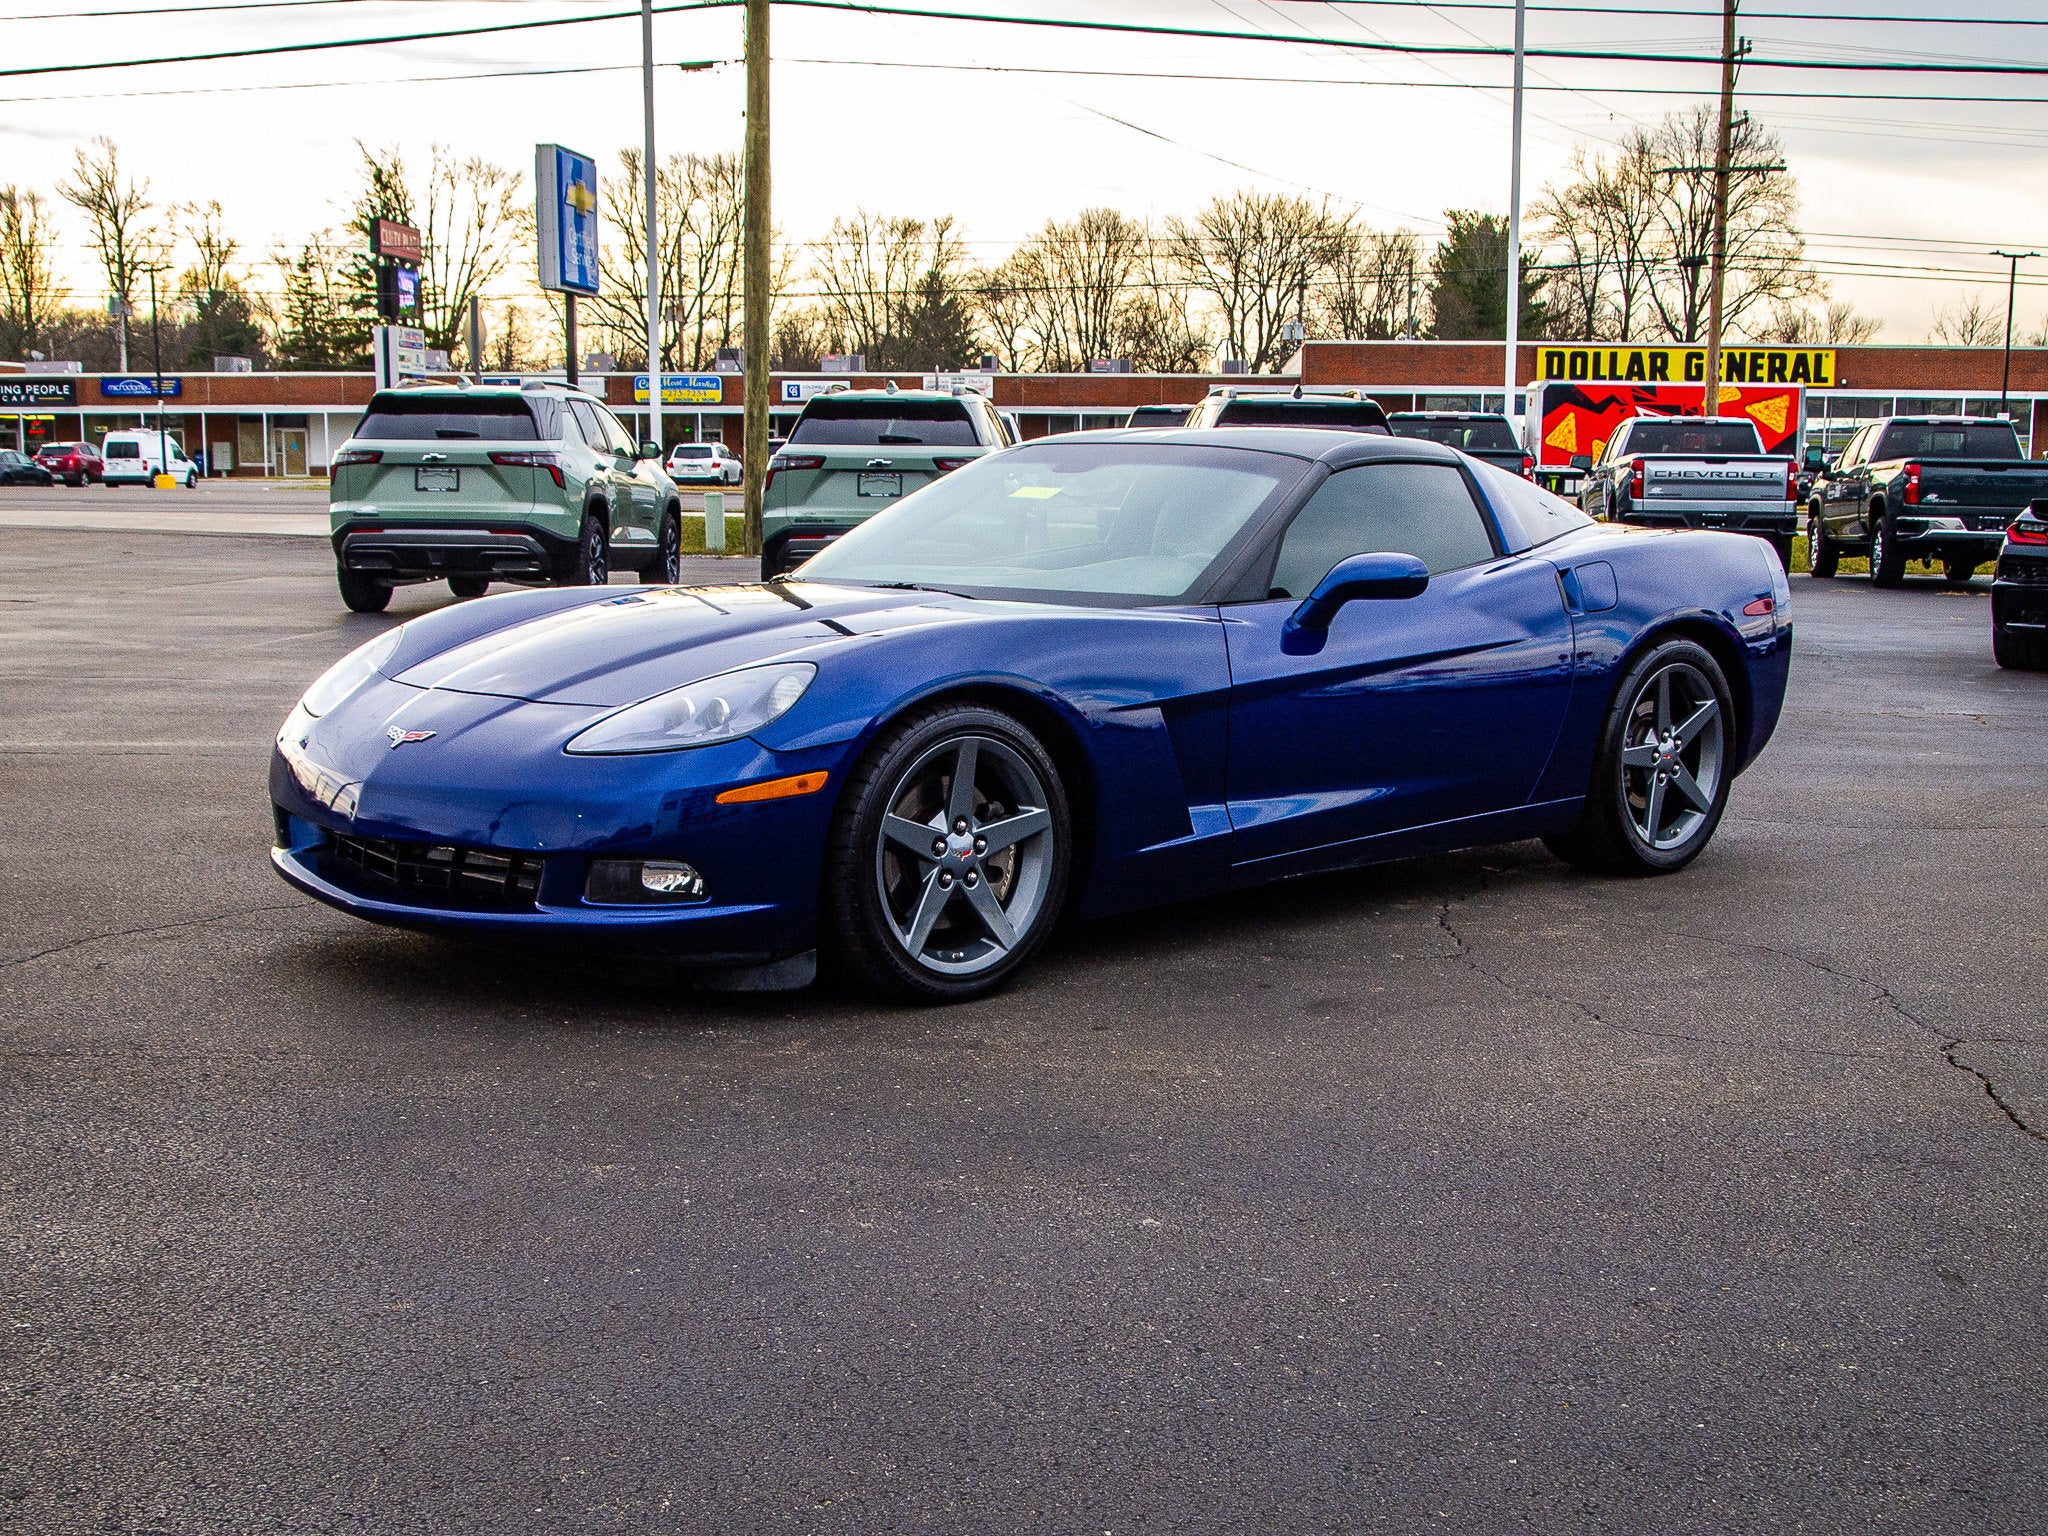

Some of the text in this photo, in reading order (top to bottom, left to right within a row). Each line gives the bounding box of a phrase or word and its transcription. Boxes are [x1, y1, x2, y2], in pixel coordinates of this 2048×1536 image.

[1545, 350, 1829, 383] DOLLAR GNERAL
[686, 377, 717, 388] Market
[25, 385, 70, 395] PEOPLE
[1654, 470, 1778, 479] CHEVROLET
